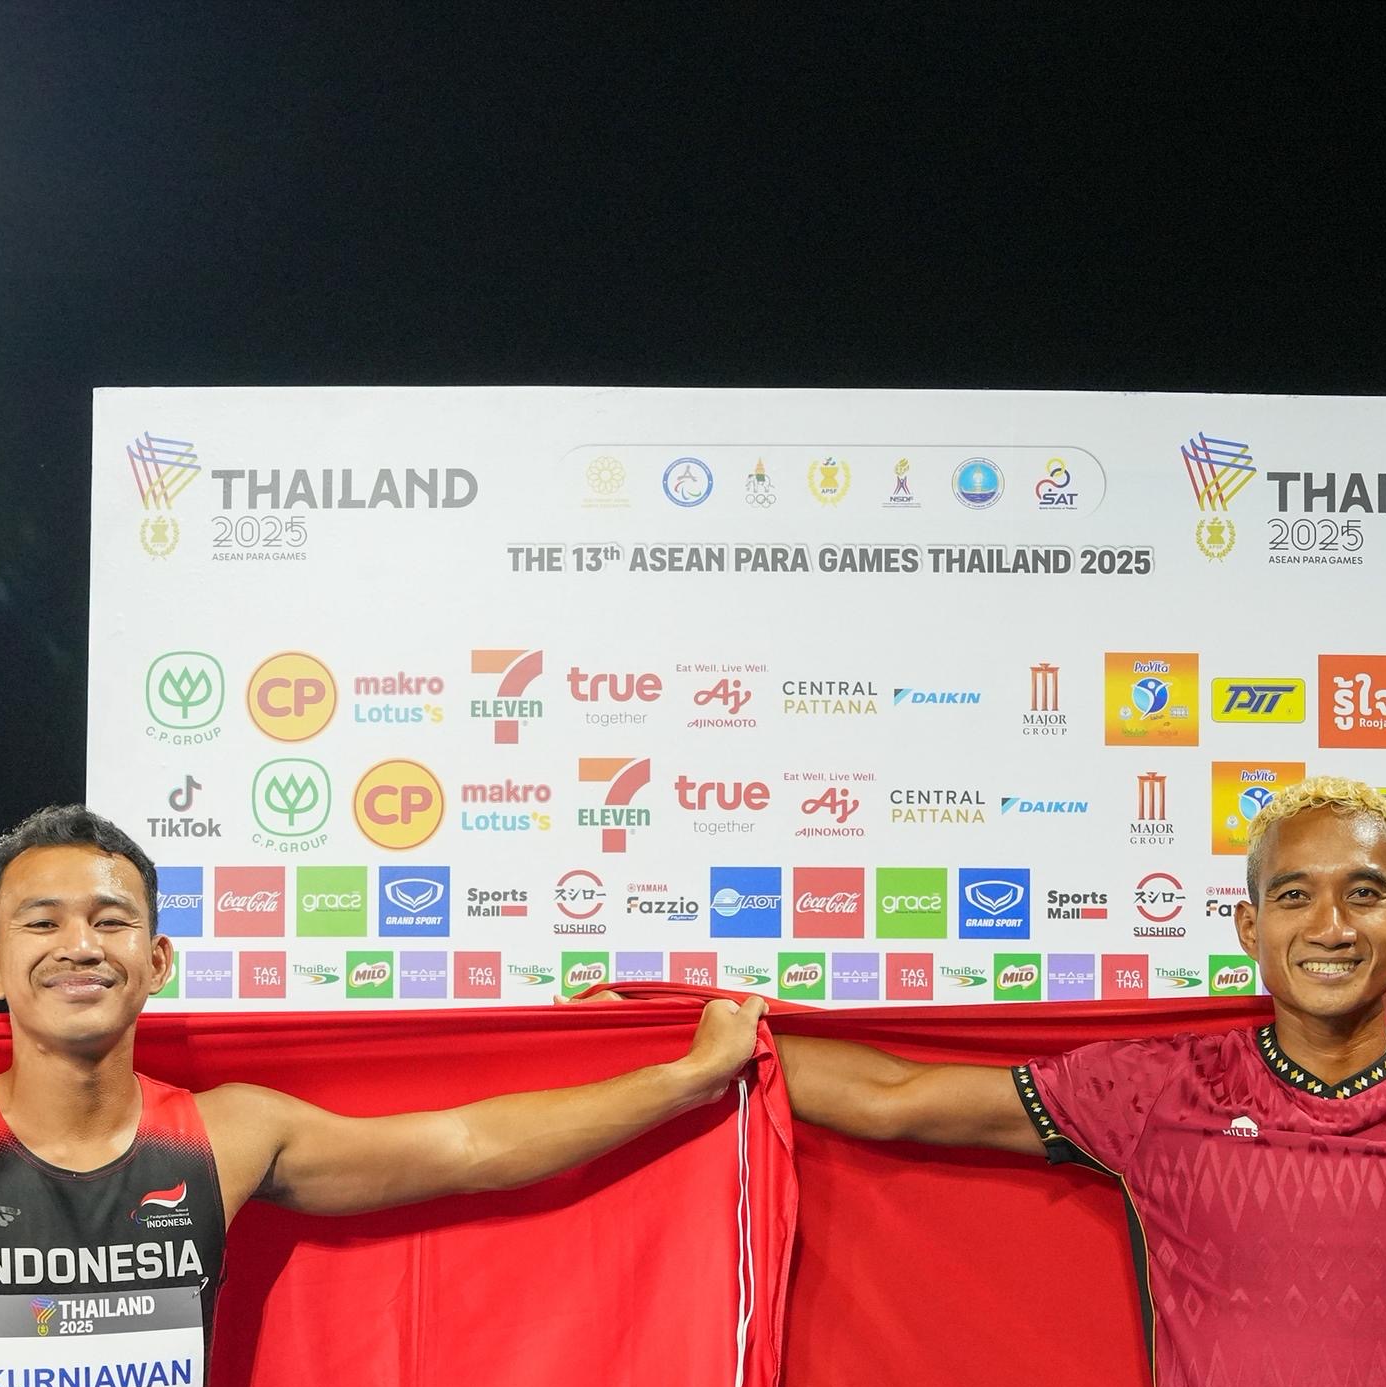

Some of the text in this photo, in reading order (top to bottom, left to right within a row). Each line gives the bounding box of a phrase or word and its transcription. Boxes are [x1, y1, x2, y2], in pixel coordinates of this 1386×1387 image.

[212, 469, 478, 509] THAILAND
[1039, 493, 1078, 505] SAT
[212, 516, 308, 547] 2025
[1267, 518, 1363, 551] 2025
[212, 552, 307, 561] ASEAN PARA GAMES
[508, 546, 1151, 575] THE 13th ASEAN PARA GAMES THAILAND 2025
[1269, 555, 1363, 565] ASEAN PARA GAMES
[676, 664, 692, 672] Eat
[722, 664, 740, 672] Live
[354, 672, 445, 695] makro
[567, 667, 663, 701] true
[782, 681, 878, 696] CENTRAL
[257, 677, 326, 717] CP
[911, 692, 981, 705] DAIKIN
[354, 704, 445, 723] Lotus's
[784, 700, 878, 715] PATTANA
[586, 712, 648, 726] together
[687, 719, 757, 729] AJINOMOTO
[1023, 714, 1067, 726] MAJOR
[1023, 728, 1067, 736] GROUP
[783, 773, 800, 781] Eat
[829, 773, 850, 781] Live
[461, 779, 551, 803] makro
[675, 775, 770, 811] true
[890, 790, 985, 805] CENTRAL
[363, 785, 433, 825] CP
[1018, 801, 1088, 813] DAIKIN
[461, 811, 551, 831] Lotus's
[891, 809, 985, 823] PATTANA
[147, 818, 222, 838] TikTok
[693, 820, 755, 835] together
[795, 828, 865, 838] AJINOMOTO
[1130, 823, 1174, 835] MAJOR
[1130, 837, 1174, 845] GROUP
[636, 884, 668, 892] YAMAHA
[467, 887, 528, 903] Sports
[553, 888, 607, 902] スシロー
[1047, 890, 1108, 905] Sports
[1134, 891, 1186, 904] スシロー
[627, 896, 699, 914] Fazzio
[742, 895, 781, 909] AOT
[467, 905, 501, 917] Mall
[1047, 908, 1081, 920] Mall
[386, 916, 443, 926] GRAND SPORT
[965, 918, 1023, 927] GRAND SPORT
[553, 924, 607, 935] SUSHIRO
[1133, 927, 1186, 937] SUSHIRO
[254, 967, 278, 976] TAG
[292, 964, 338, 974] ThaiBev
[354, 969, 387, 981] MILO
[469, 967, 493, 976] TAG
[508, 964, 554, 974] ThaiBev
[570, 968, 602, 982] MILO
[684, 968, 709, 976] TAG
[724, 965, 769, 974] ThaiBev
[901, 969, 925, 978] TAG
[939, 966, 986, 976] ThaiBev
[1116, 970, 1140, 979] TAG
[1155, 967, 1201, 977] ThaiBev
[786, 969, 818, 983] MILO
[1002, 971, 1034, 983] MILO
[1217, 972, 1249, 985] MILO
[1223, 1128, 1259, 1137] MILLS
[146, 1218, 193, 1229] INDONESIA
[59, 1296, 155, 1320] THAILAND
[59, 1320, 94, 1334] 2025
